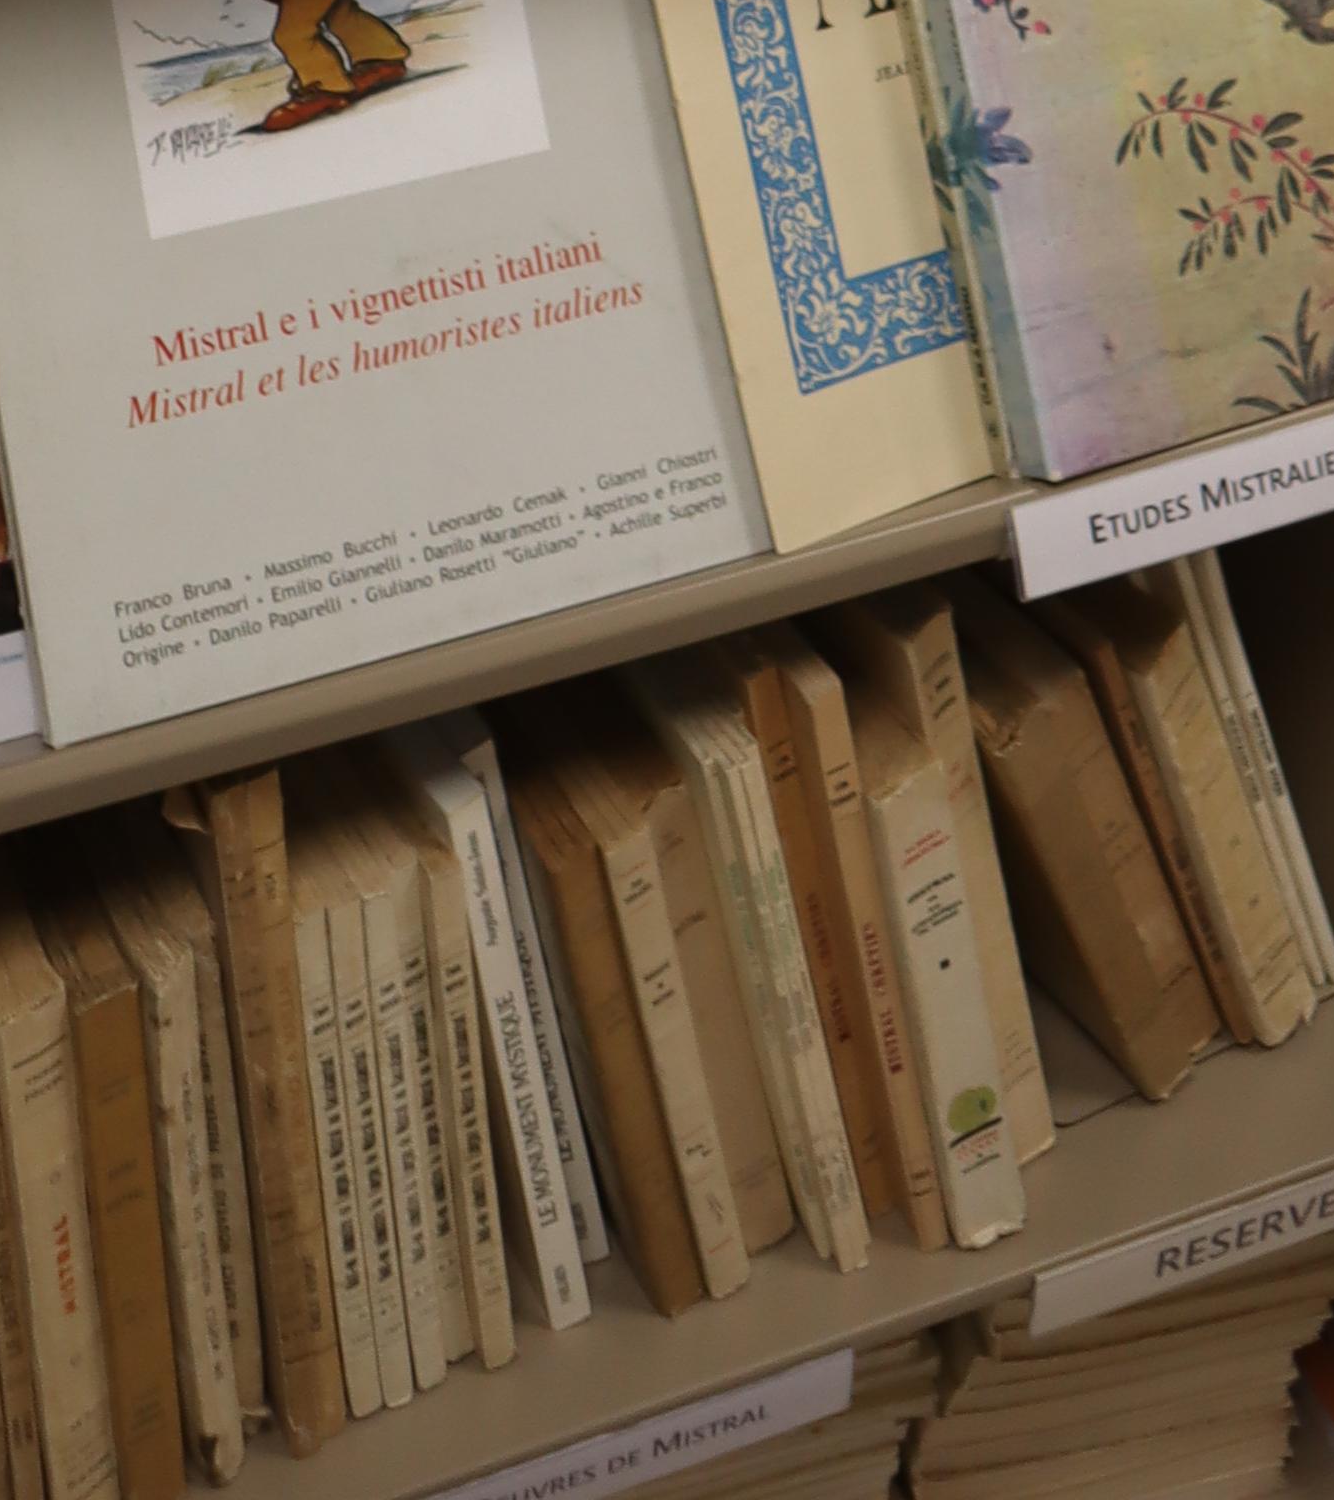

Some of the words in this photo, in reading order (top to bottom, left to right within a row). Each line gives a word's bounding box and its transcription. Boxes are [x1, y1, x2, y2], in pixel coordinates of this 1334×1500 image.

[126, 371, 245, 429] Mistral
[258, 366, 287, 398] et
[296, 353, 341, 389] les
[351, 312, 523, 375] humoristes
[531, 278, 645, 330] italiens
[152, 309, 269, 368] Mistral
[279, 312, 297, 335] e
[307, 299, 321, 331] i
[328, 259, 488, 328] vignettisti
[493, 231, 604, 286] italiani
[113, 590, 173, 618] Franco
[182, 576, 233, 600] Bruna
[264, 550, 333, 579] Massimo
[343, 530, 398, 558] Bucchi
[427, 504, 503, 536] Leonardo
[597, 465, 647, 491] Gianni
[656, 446, 717, 475] Chiostri
[119, 620, 156, 644] Lido
[271, 576, 323, 603] Emilio
[328, 557, 402, 588] Giannelli
[423, 538, 474, 563] Danilo
[479, 514, 562, 547] Maramotti
[583, 490, 649, 520] Agostino
[654, 488, 664, 500] e
[669, 471, 723, 496] Franco
